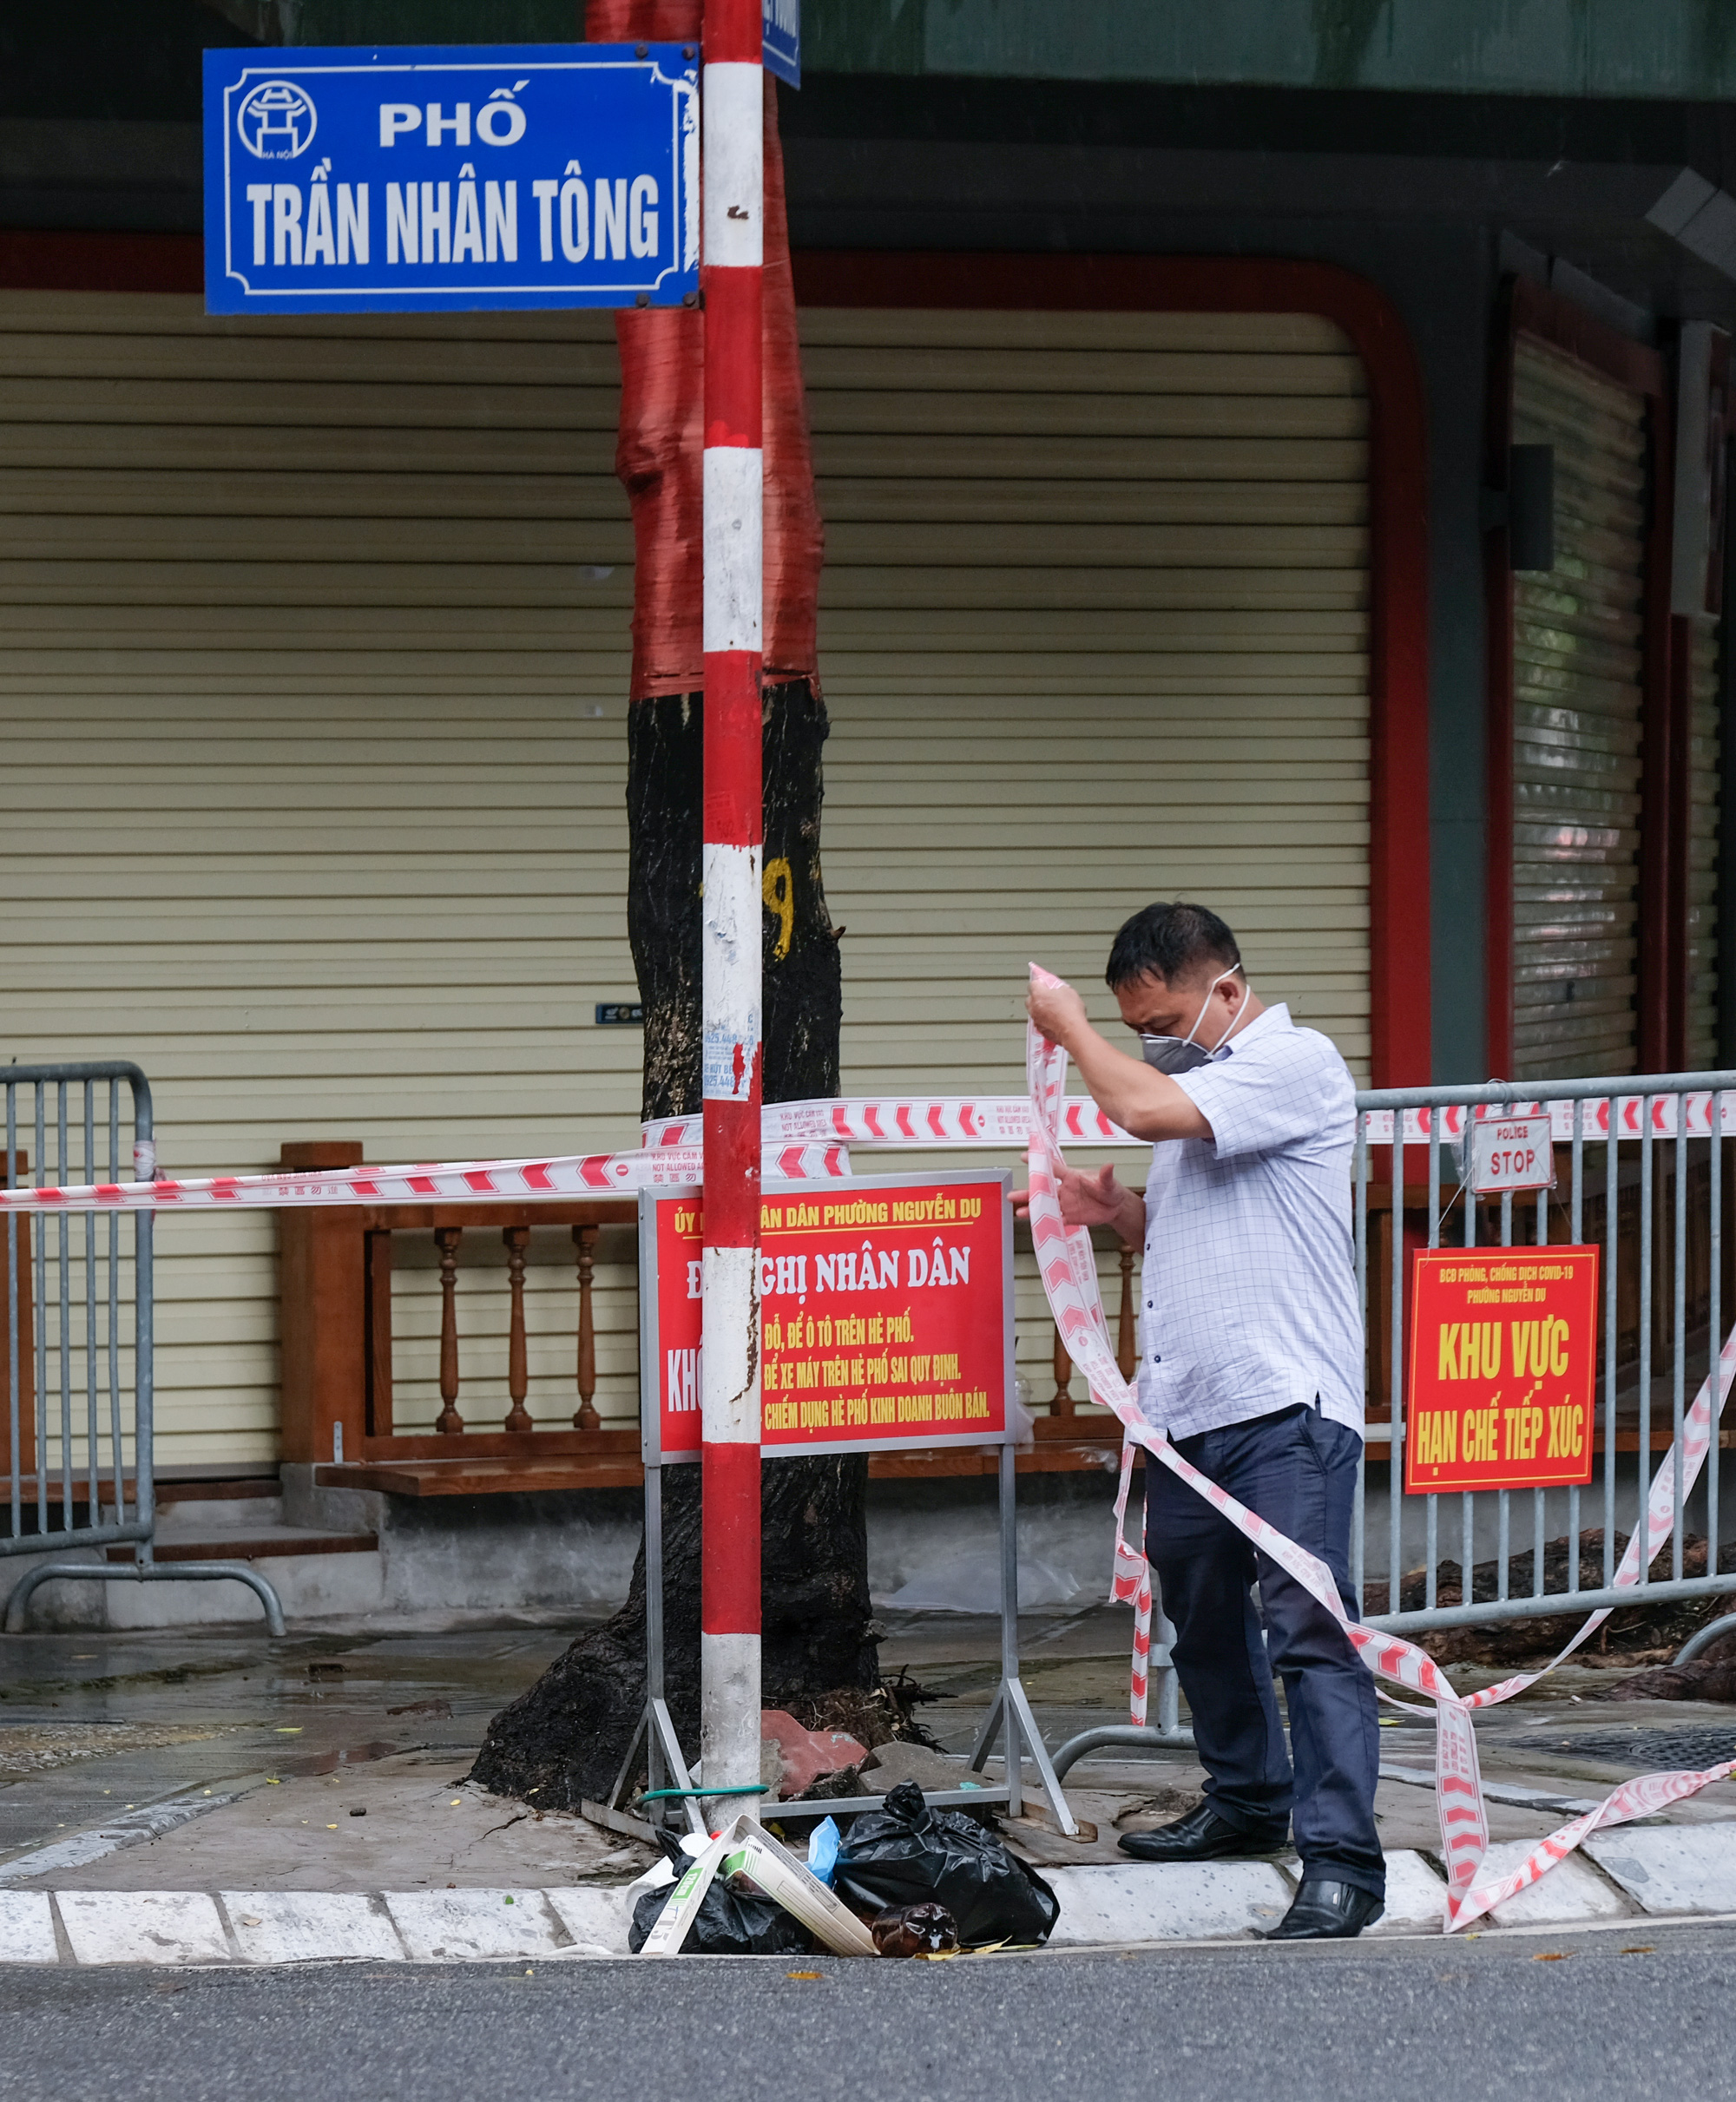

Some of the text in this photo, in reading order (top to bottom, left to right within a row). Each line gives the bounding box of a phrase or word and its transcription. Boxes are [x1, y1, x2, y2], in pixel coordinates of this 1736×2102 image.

[379, 80, 530, 148] PHỐ
[247, 157, 659, 266] TRẦN NHÂN TÔNG
[1497, 1126, 1528, 1140] POLICE
[1490, 1149, 1535, 1175] STOP
[674, 1206, 695, 1233] ỦY
[760, 1205, 782, 1228] ÂN
[786, 1203, 820, 1227] DÂN
[825, 1199, 888, 1225] PHƯỜNG
[892, 1192, 956, 1222] NGUYỄN
[960, 1198, 982, 1219] DU
[687, 1236, 970, 1304] Đ GHỊ NHÂN DÂN
[1539, 1265, 1574, 1280] COVID-19
[1535, 1288, 1546, 1302] DU
[787, 1310, 804, 1349] ĐỂ
[806, 1316, 814, 1348] Ô
[817, 1315, 832, 1347] TÔ
[835, 1313, 865, 1346] TRÊN
[868, 1312, 884, 1344] HÈ
[886, 1306, 914, 1343] PHỐ.
[764, 1348, 962, 1390] ĐỂ XE MÁY TRÊN HÈ PHỐ SAI QUY ĐỊNH.
[1438, 1314, 1569, 1389] KHU VỰC
[765, 1386, 990, 1434] CHIẾM DỤNG HÈ PHỐ KINH DOANH BUÔN BÁN.
[1417, 1389, 1583, 1476] HẠN CHẾ TIẾP XÚC
